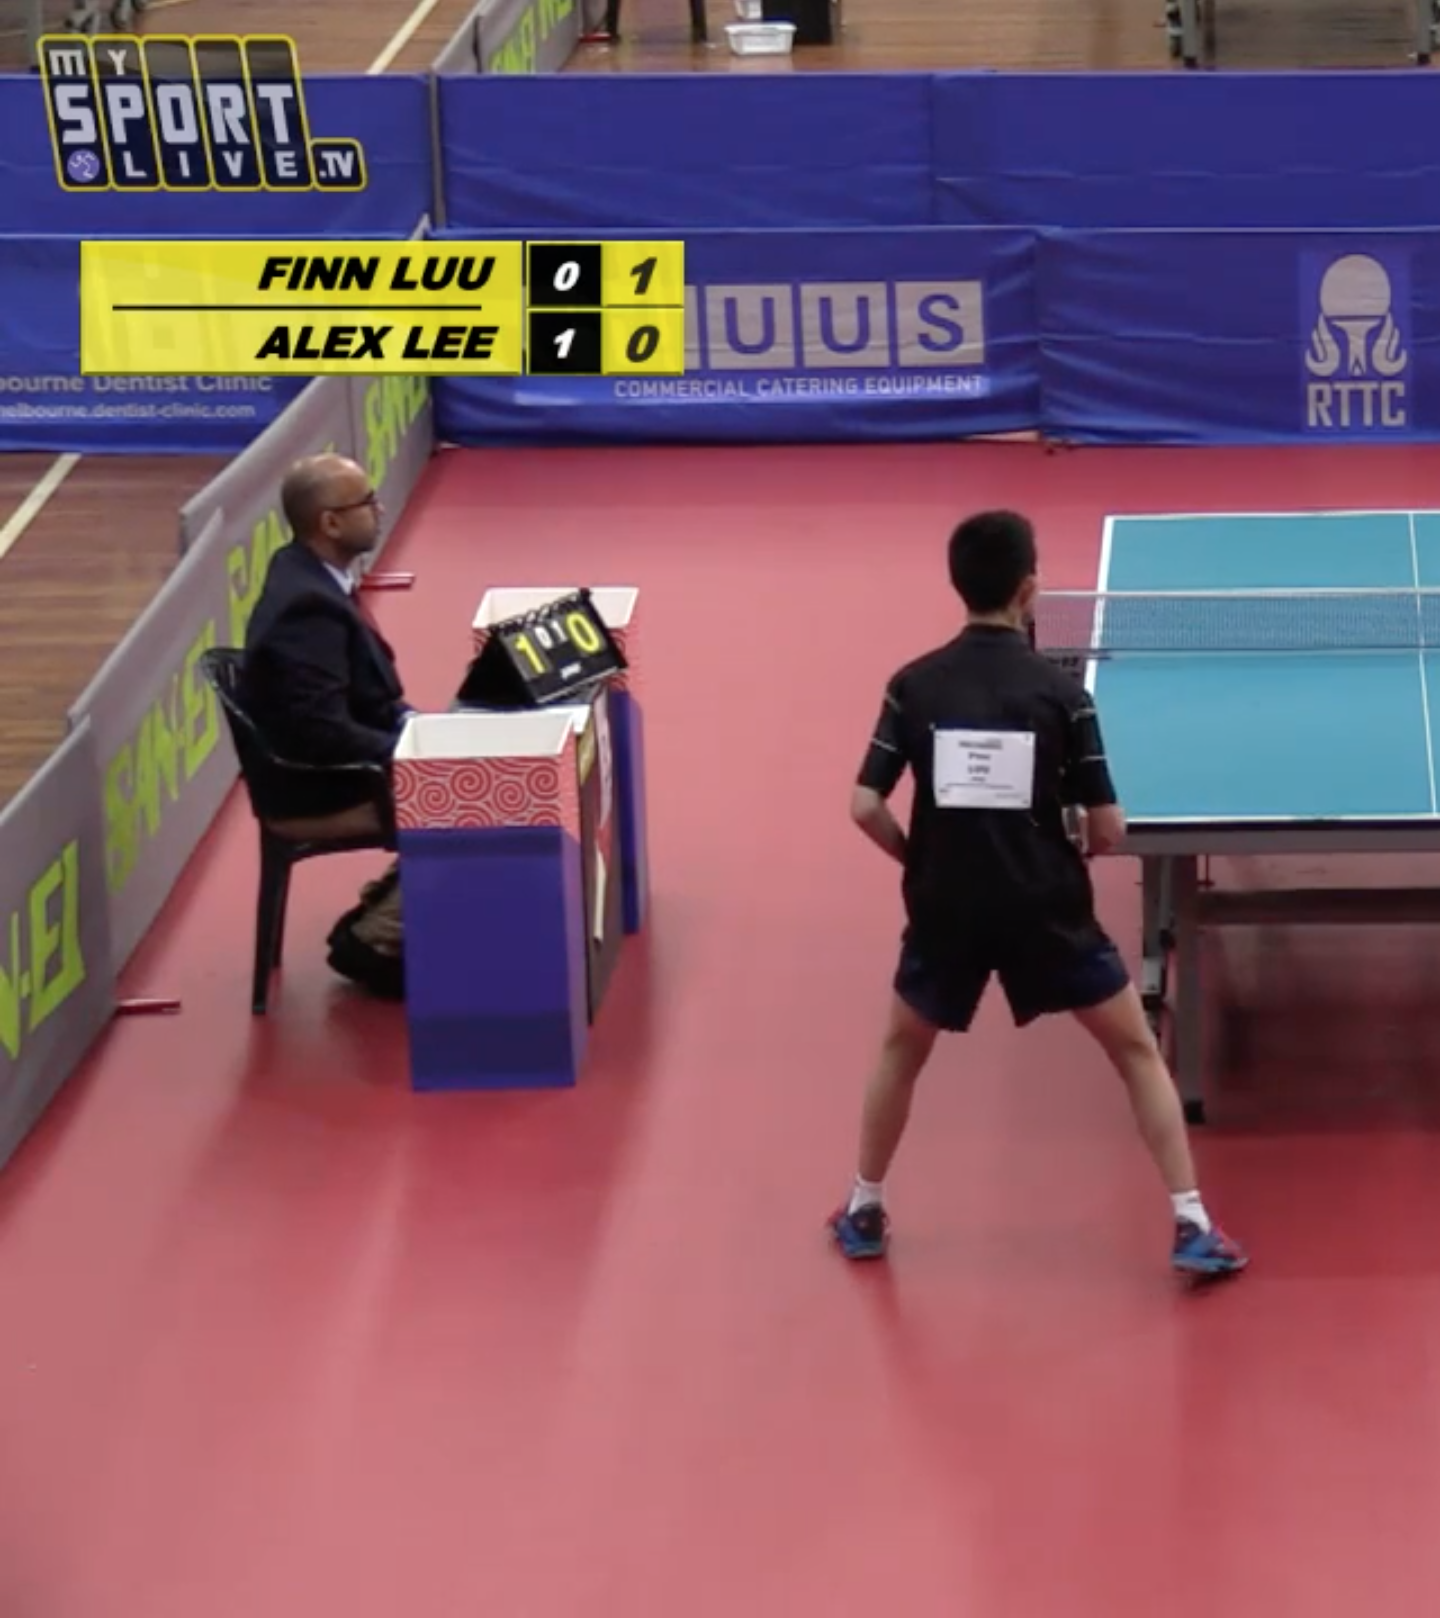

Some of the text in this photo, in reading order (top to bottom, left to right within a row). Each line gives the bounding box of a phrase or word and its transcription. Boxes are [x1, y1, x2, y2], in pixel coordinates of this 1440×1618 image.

[614, 374, 984, 398] COMMERCIAL CATERING EQUIPMENT
[1307, 379, 1406, 428] RTTC
[514, 631, 546, 675] 1
[565, 611, 602, 654] 0
